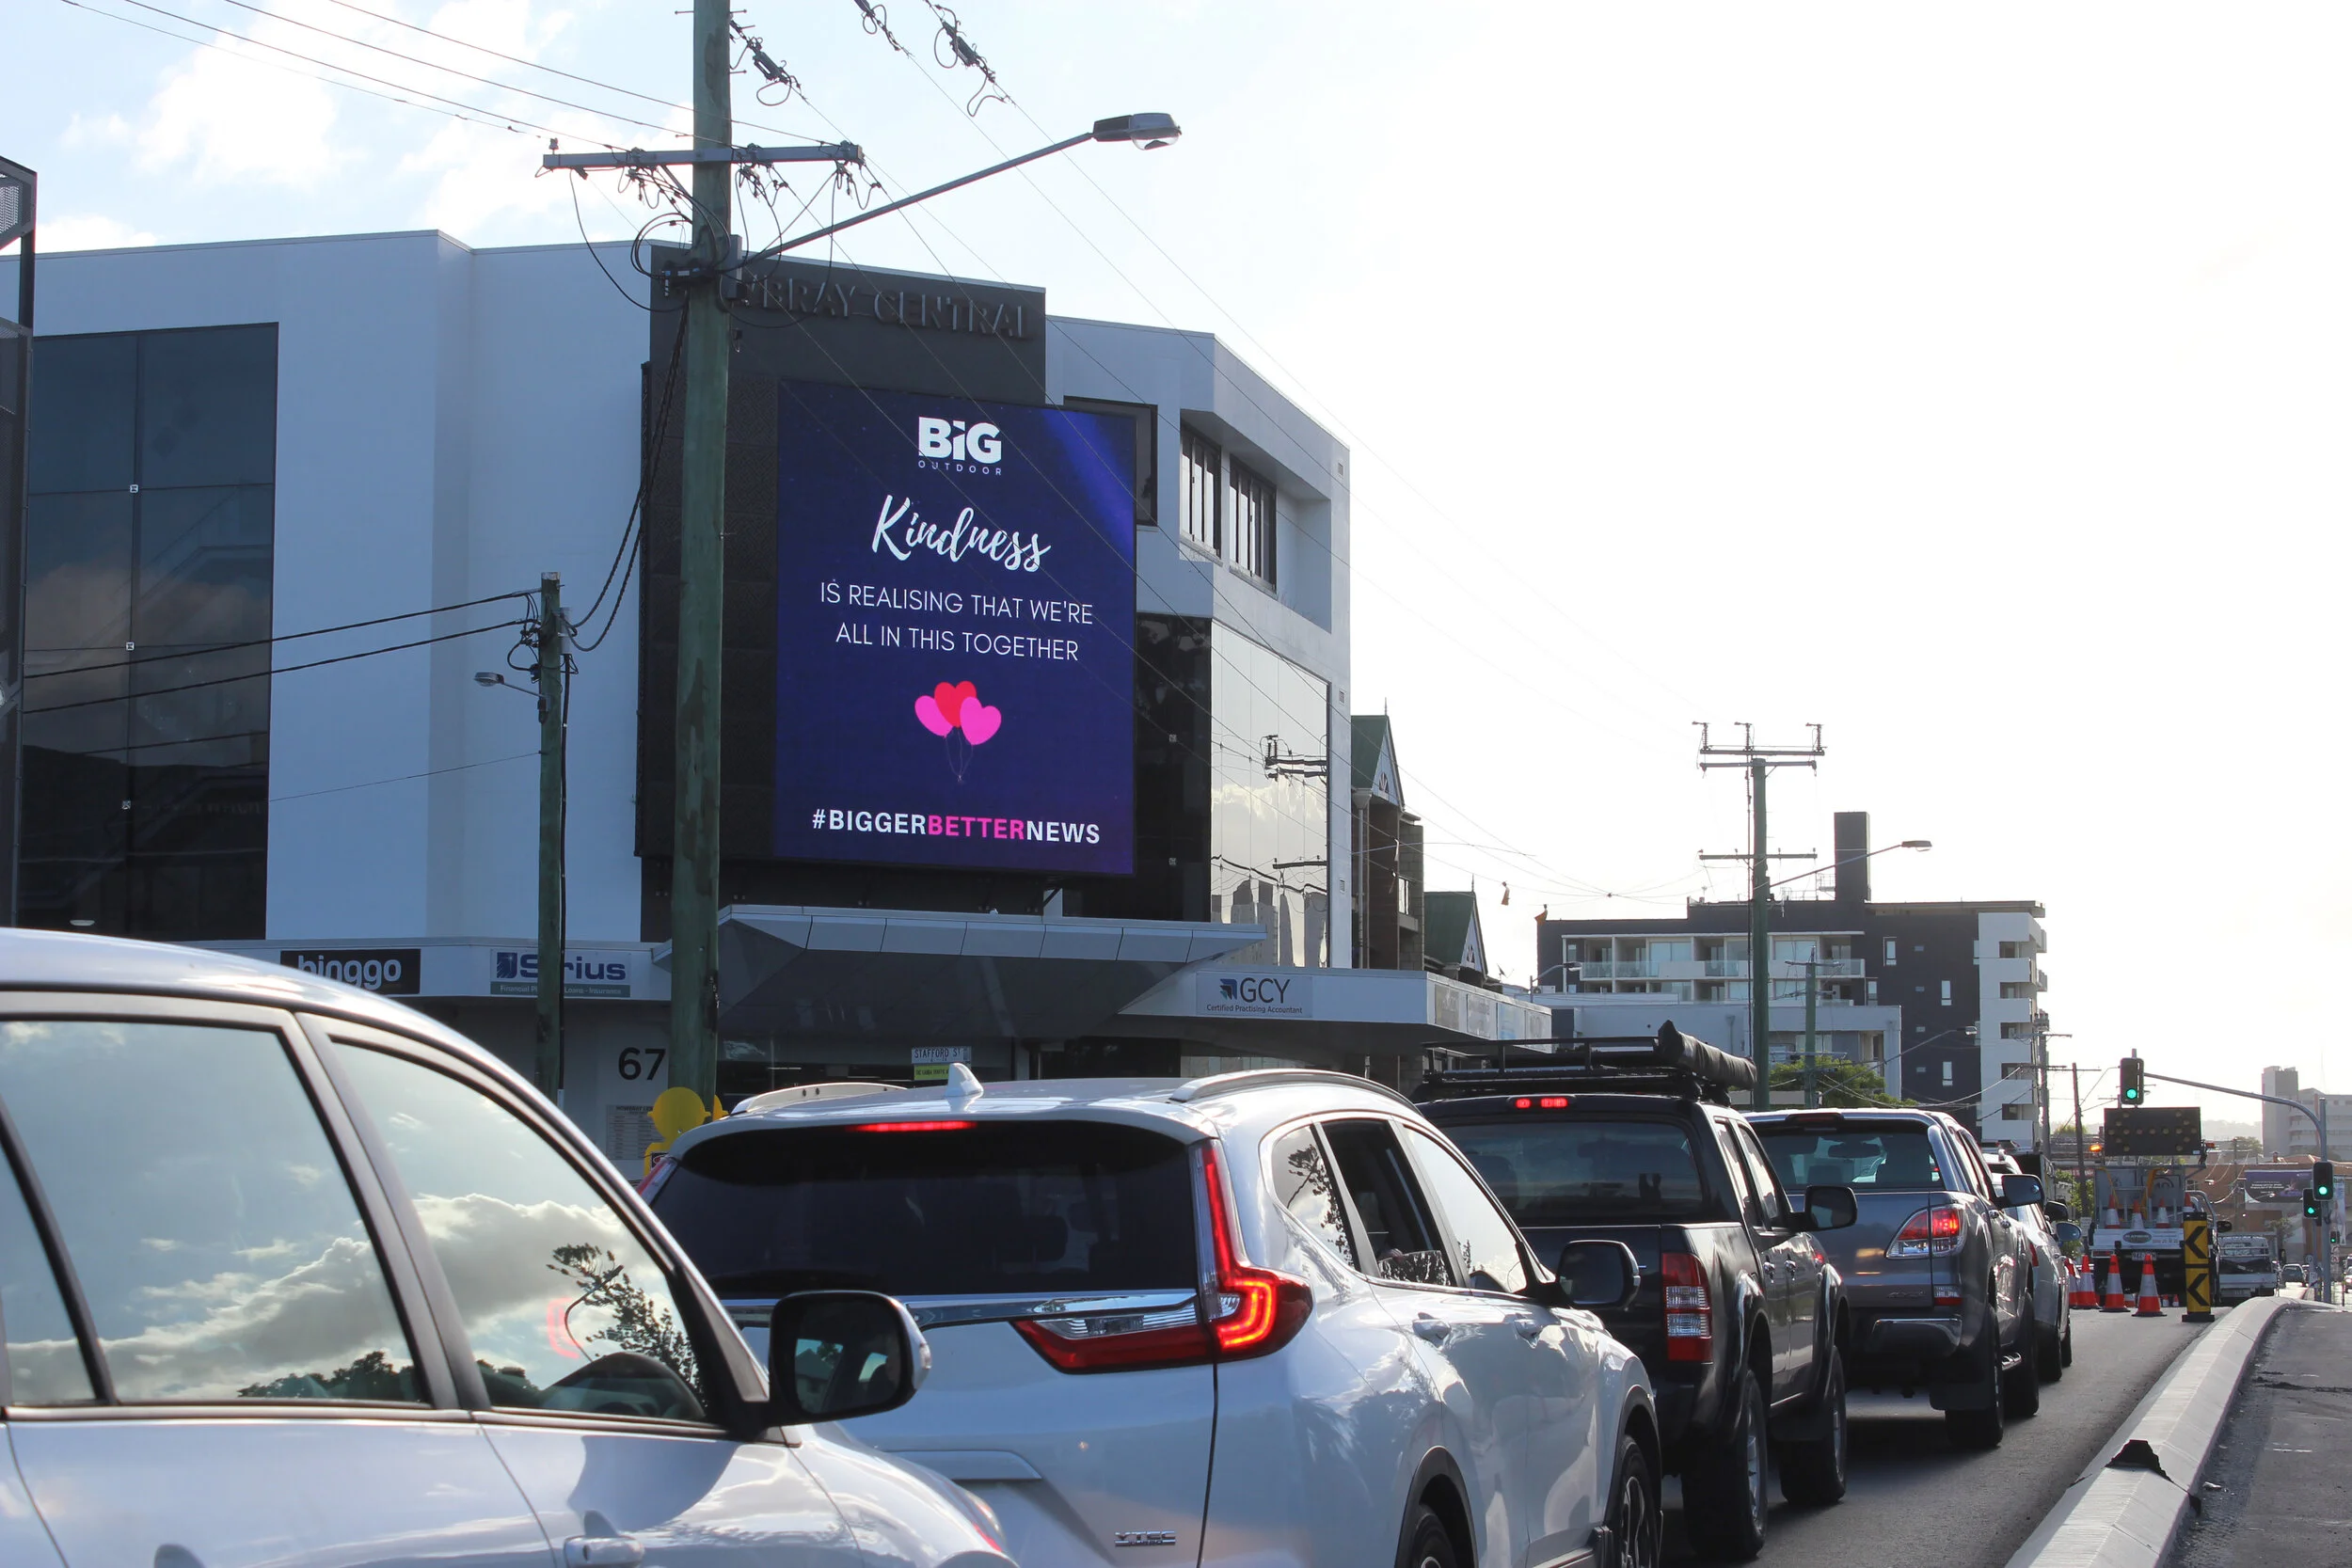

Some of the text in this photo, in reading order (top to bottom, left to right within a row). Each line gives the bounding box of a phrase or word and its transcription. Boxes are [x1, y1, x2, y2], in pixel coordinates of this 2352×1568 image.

[873, 289, 1031, 340] CENTRAL
[917, 460, 1003, 477] OUTDOOR
[871, 494, 1052, 573] Kindness
[820, 581, 1093, 626] IS REALISING THAT WE'RE
[835, 622, 1079, 662] ALL IN THIS TOGETHER
[812, 808, 1101, 845] #BIGGERBETTERNEWS
[519, 954, 627, 981] Srius
[1239, 976, 1291, 1004] GCY
[1206, 1004, 1303, 1014] Certified Practising Accountant
[617, 1047, 667, 1082] 67
[914, 1048, 949, 1058] STAFFORD
